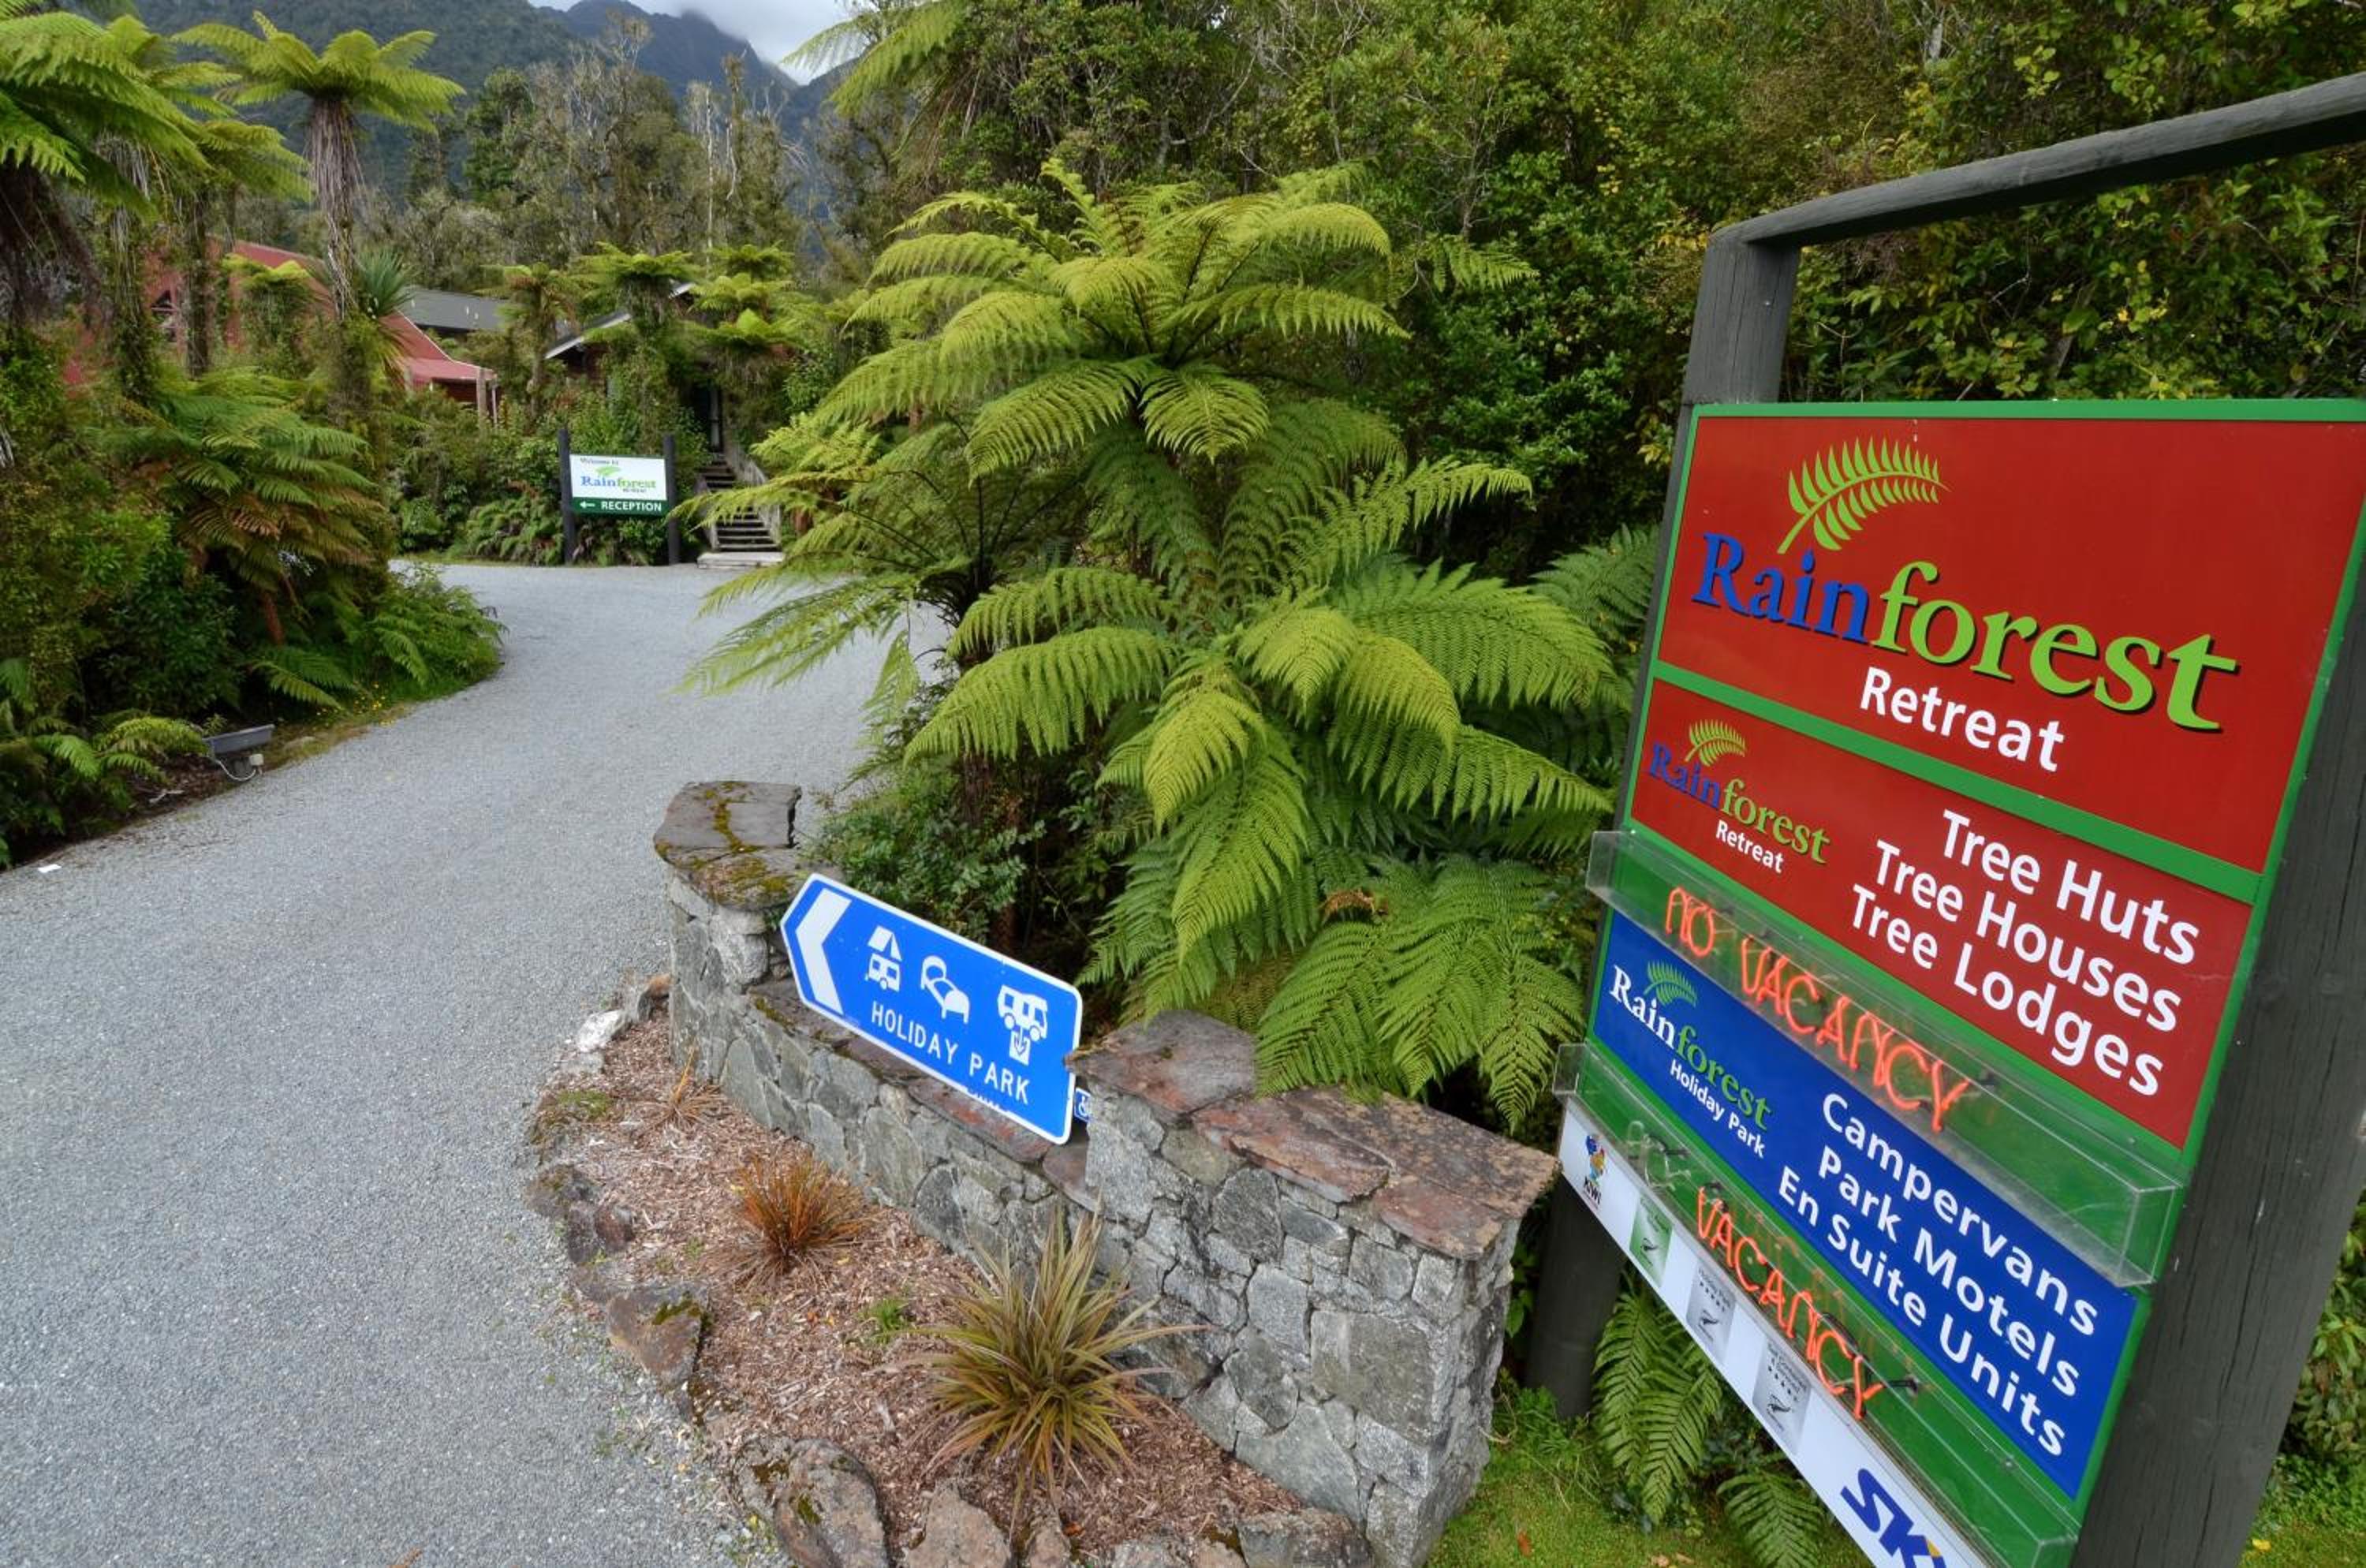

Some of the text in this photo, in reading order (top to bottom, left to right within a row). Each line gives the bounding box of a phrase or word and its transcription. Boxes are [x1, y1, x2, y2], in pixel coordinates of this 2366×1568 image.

[580, 476, 656, 488] Rainforest
[601, 500, 662, 512] RECEPTION
[1691, 532, 2238, 732] Rainforest
[1860, 666, 2065, 772] Retreat
[1649, 741, 1830, 864] Rainforest
[1715, 819, 1785, 873] Retreat
[1876, 839, 2181, 1032] Tree Houses
[1942, 809, 2200, 965] Tree Huts
[871, 1000, 1031, 1104] HOLIDAY PARK
[1609, 965, 1774, 1131] Rainforest
[1665, 886, 1971, 1133] NO VACANCY
[1853, 883, 2163, 1096] Tree Lodges
[1670, 1058, 1766, 1159] Holiday Park
[1819, 1146, 1901, 1243] Park
[1914, 1227, 2080, 1396] Motels
[1823, 1092, 2099, 1335] Campervans
[1698, 1185, 1883, 1420] VACANCY
[1778, 1166, 1819, 1226] En
[1827, 1214, 1926, 1327] Suite
[1940, 1314, 2065, 1456] Units
